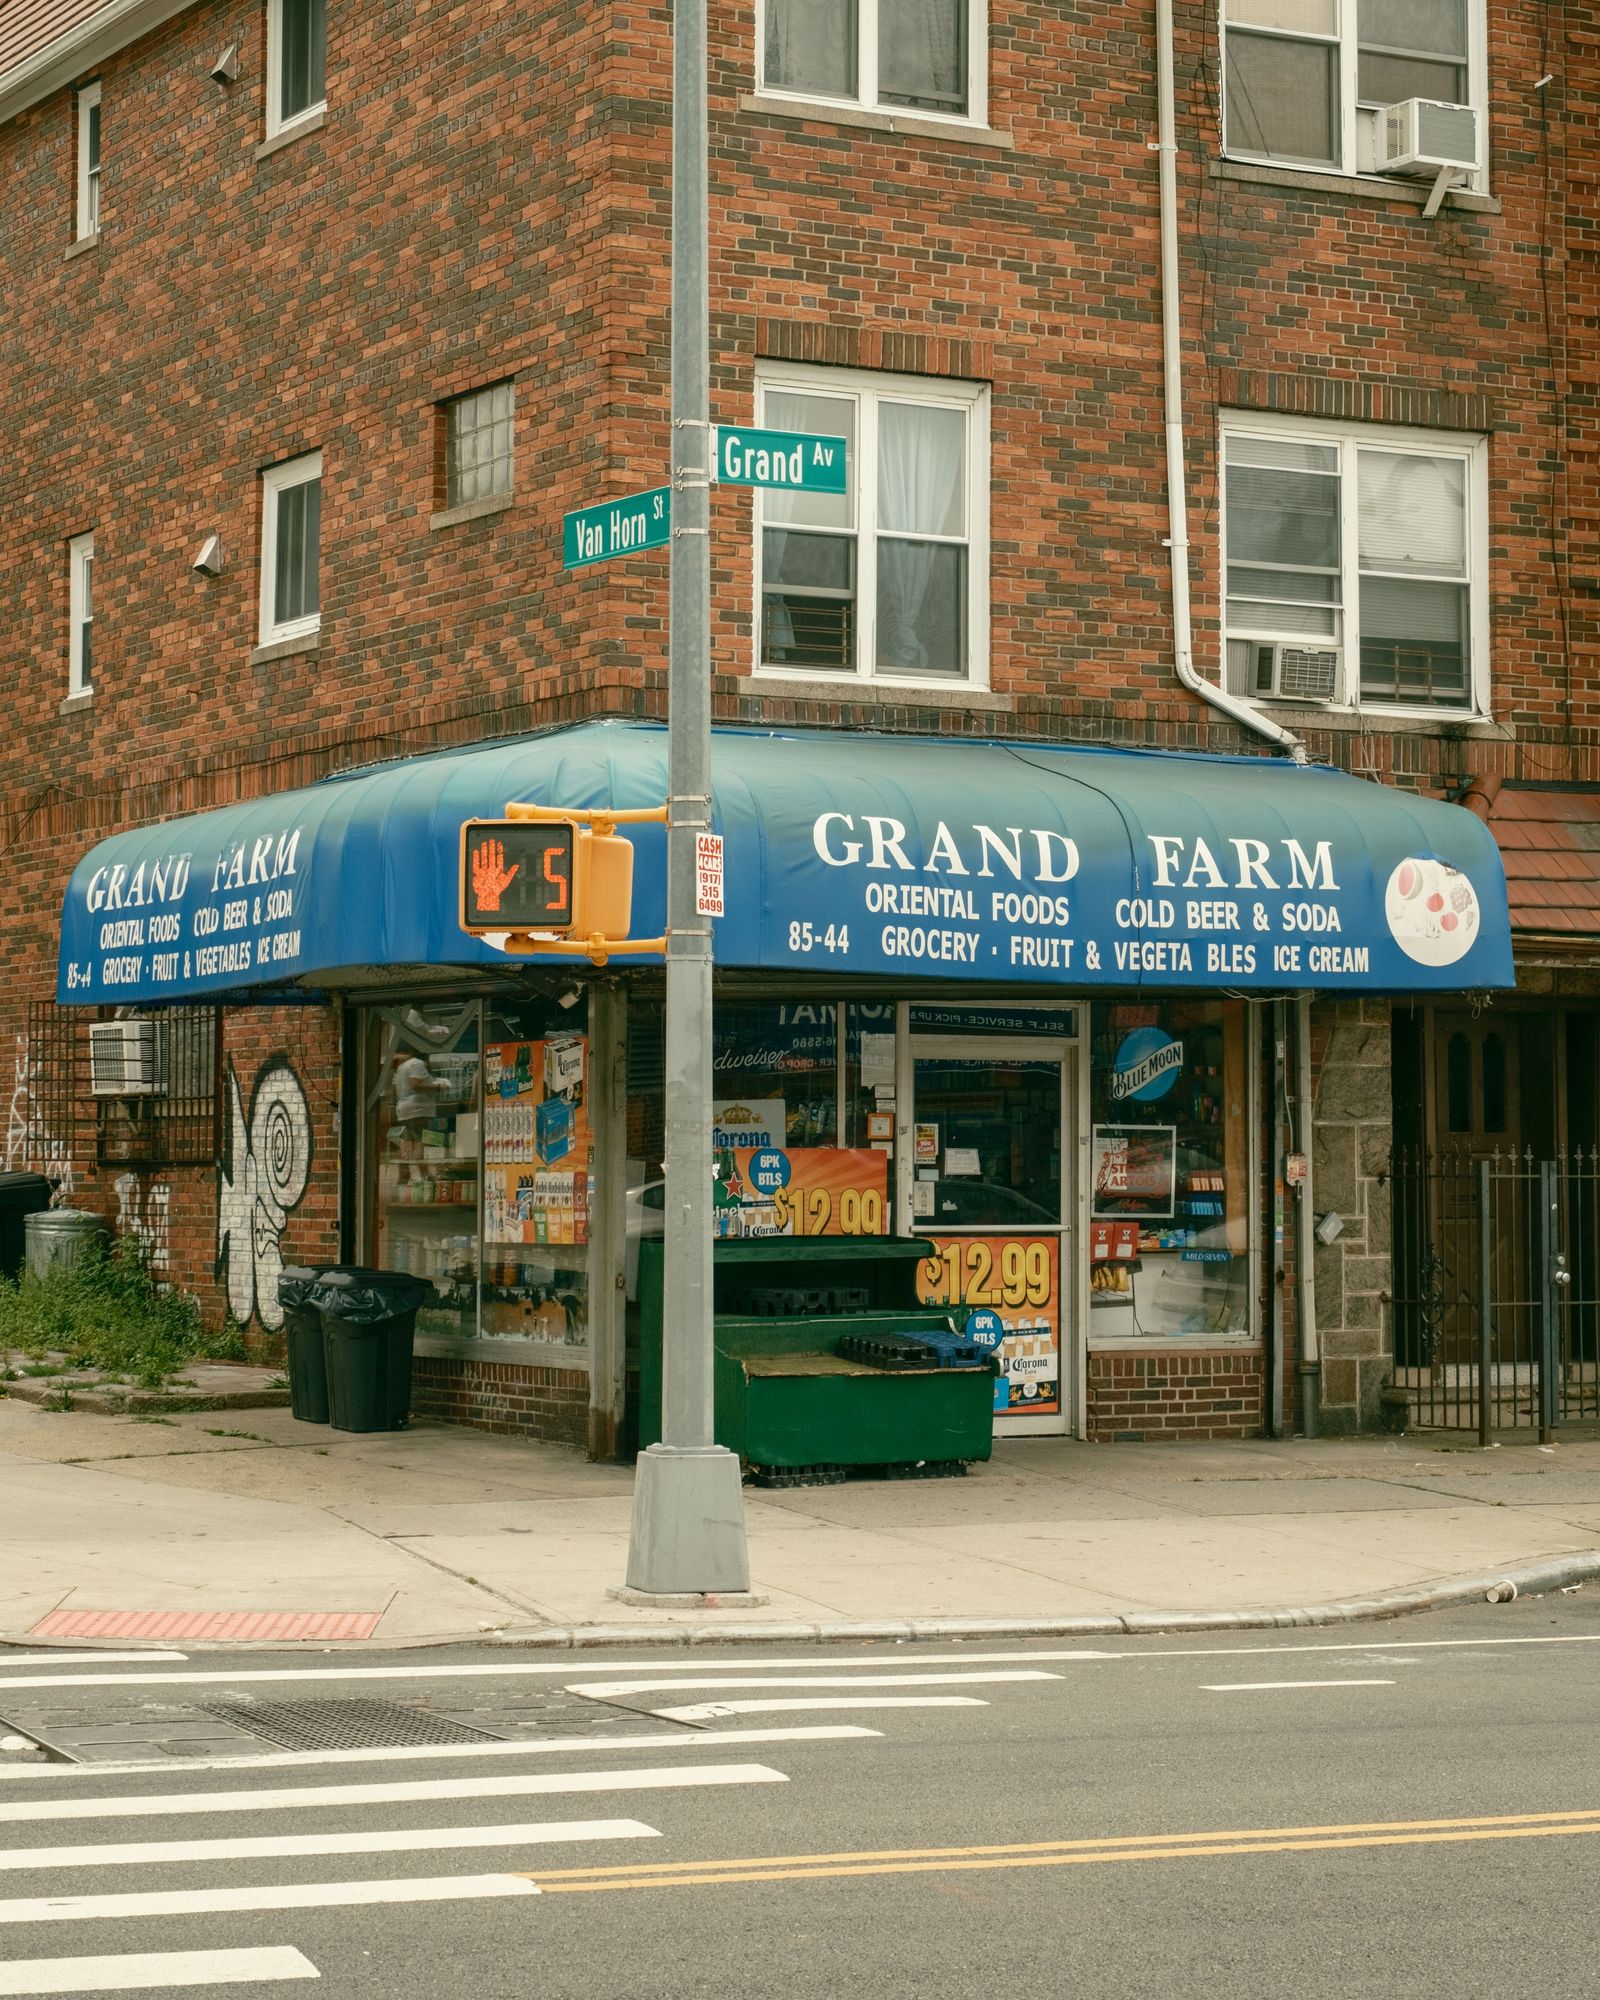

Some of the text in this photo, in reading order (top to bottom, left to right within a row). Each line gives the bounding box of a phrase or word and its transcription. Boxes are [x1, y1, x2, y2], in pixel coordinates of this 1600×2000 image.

[724, 436, 834, 484] Grand Av
[575, 494, 664, 560] Van Horn St
[86, 824, 306, 914] GRAND FARM
[812, 811, 1341, 891] GRAND FARM
[543, 847, 568, 910] 5
[699, 872, 721, 885] (917)
[702, 884, 719, 899] 515
[100, 888, 292, 950] ORIENTAL FOODS COLD BEER & SODA
[698, 898, 723, 913] 6499
[865, 882, 1342, 932] ORIENTAL FOODS COLD BEER & SODA
[103, 955, 142, 985] GROCERY
[152, 951, 179, 981] FRUIT
[183, 950, 191, 978] &
[196, 940, 251, 977] VEGETABLES
[257, 936, 270, 965] ICE
[272, 930, 301, 961] CREAM
[788, 920, 849, 954] 85-44
[881, 926, 980, 962] GROCERY
[1010, 936, 1074, 968] FRUIT
[1085, 940, 1102, 970] &
[1273, 944, 1301, 971] ICE
[1308, 945, 1369, 973] CREAM
[758, 1172, 783, 1186] BTLS
[759, 1155, 780, 1168] 6PK
[924, 1239, 1051, 1306] $12.99
[975, 1316, 994, 1329] 6PK
[1012, 1357, 1048, 1374] Corona
